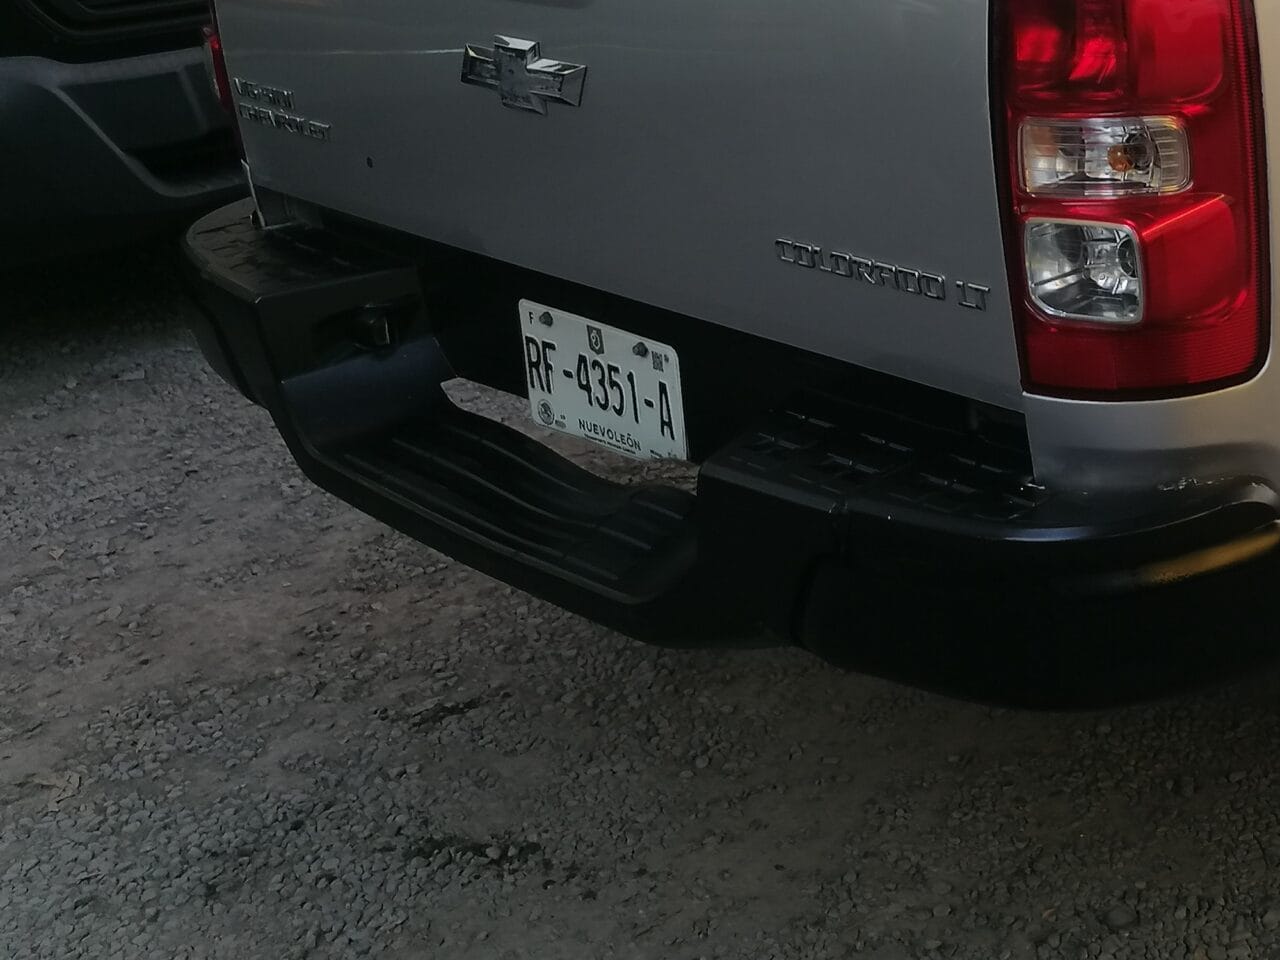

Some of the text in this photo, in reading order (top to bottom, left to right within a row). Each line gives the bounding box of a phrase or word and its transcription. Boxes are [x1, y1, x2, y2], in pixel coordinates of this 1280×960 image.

[775, 238, 991, 312] COLORADO LT
[525, 335, 676, 441] RF-4351-A
